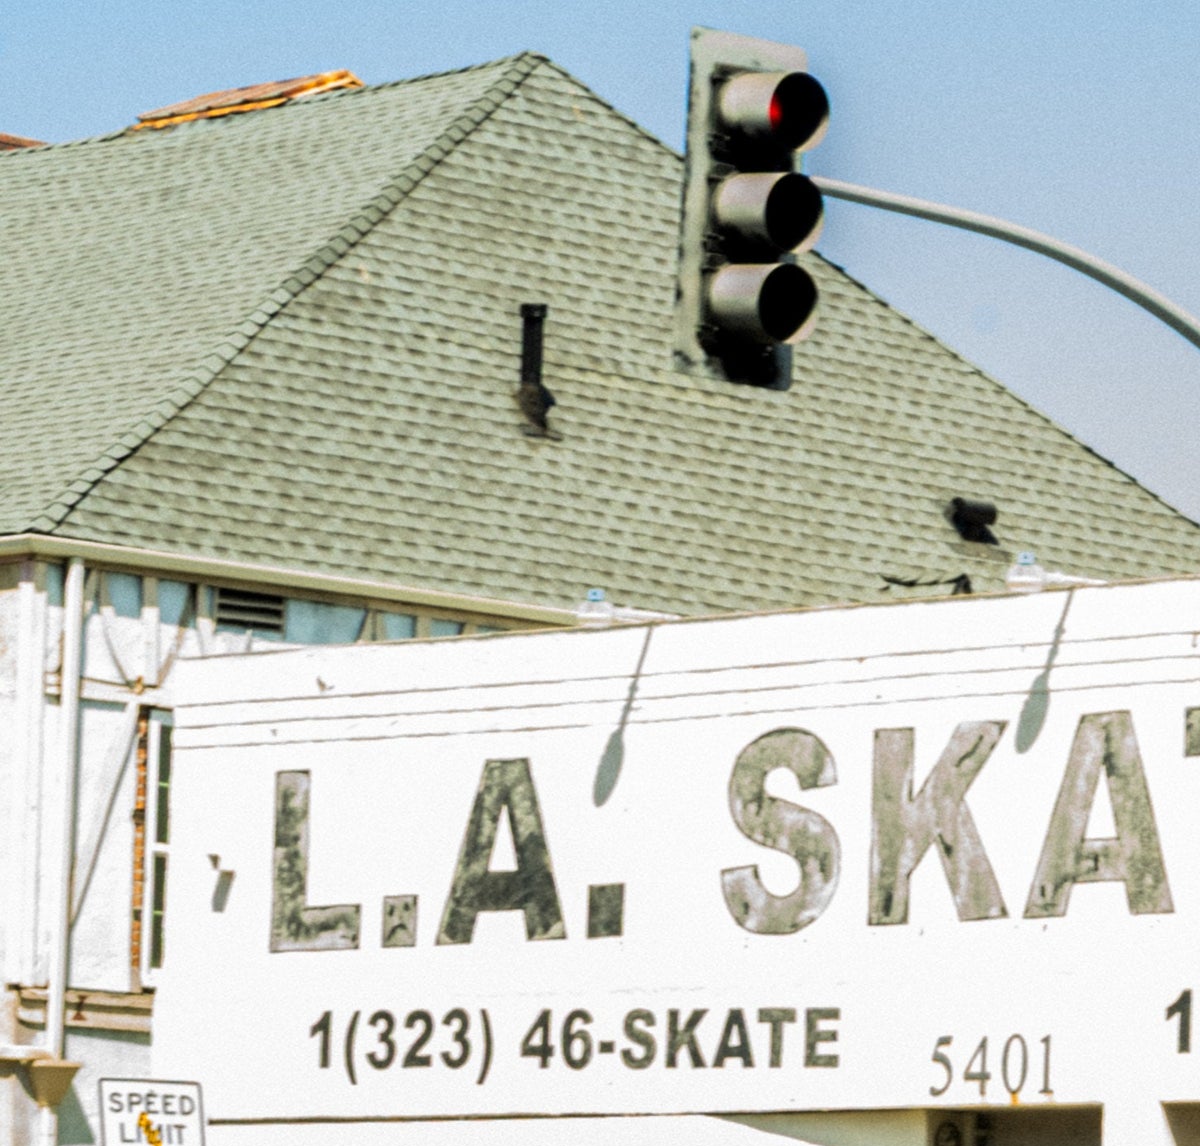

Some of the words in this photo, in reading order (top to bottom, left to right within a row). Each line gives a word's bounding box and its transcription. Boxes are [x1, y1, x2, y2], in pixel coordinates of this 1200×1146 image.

[269, 756, 626, 954] L.A.
[310, 1008, 494, 1086] 1(323)
[521, 1007, 841, 1070] 46-SKATE
[929, 1032, 1055, 1099] 5401
[108, 1091, 196, 1116] SPEED
